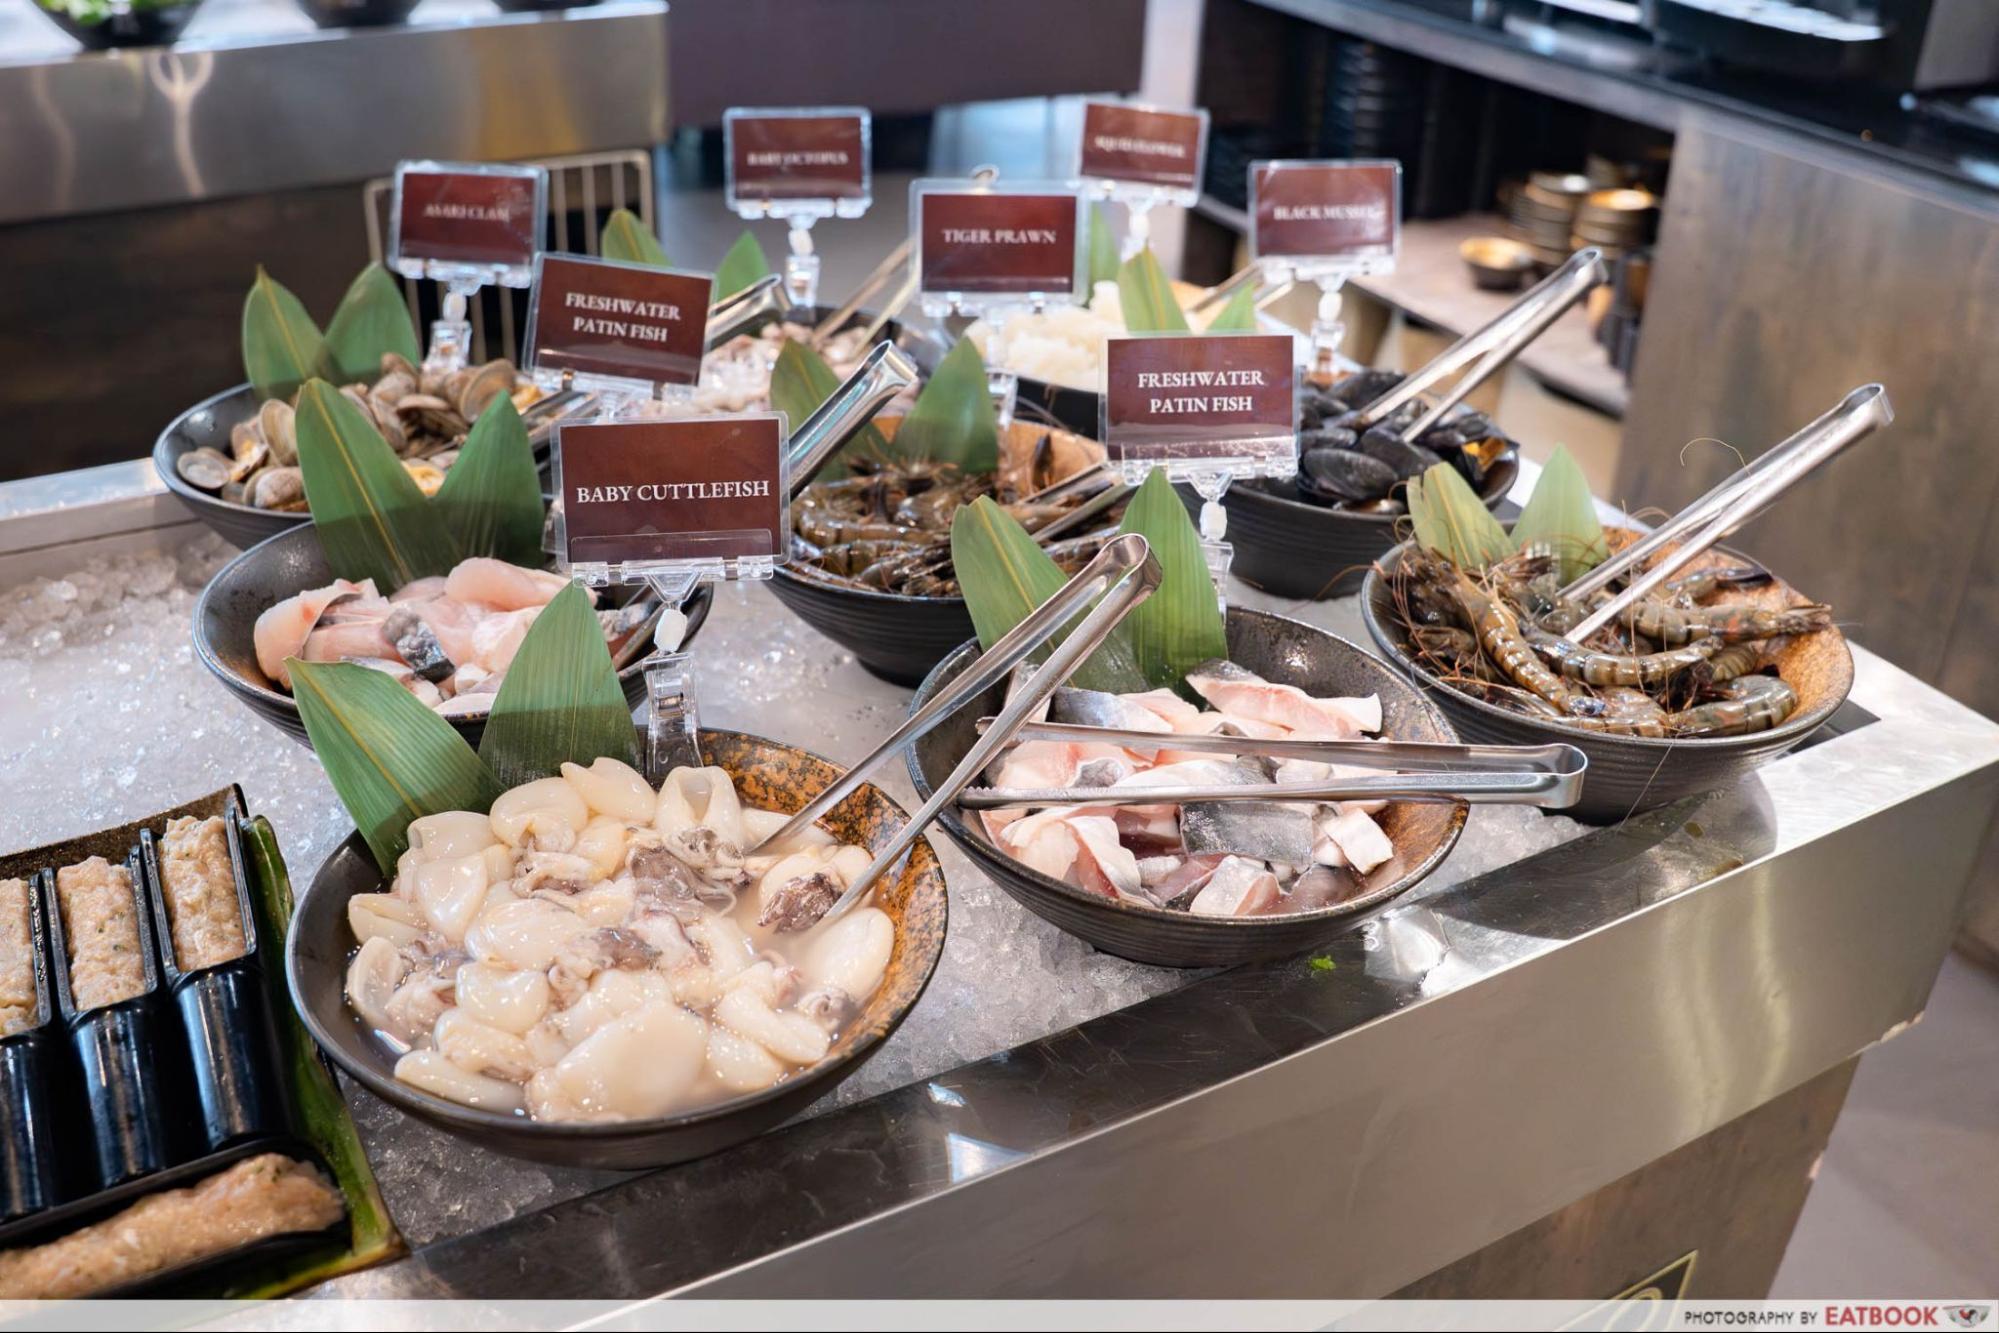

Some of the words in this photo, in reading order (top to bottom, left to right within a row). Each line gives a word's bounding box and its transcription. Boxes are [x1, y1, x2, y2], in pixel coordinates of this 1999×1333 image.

[1273, 205, 1321, 221] BLACK
[942, 228, 991, 244] TIGER
[994, 229, 1057, 245] PRAWN
[565, 292, 681, 321] FRESHWATER
[573, 317, 626, 337] PATIN
[629, 325, 668, 342] FISH
[1137, 370, 1265, 389] FRESHWATER
[1149, 397, 1209, 414] PATIN
[1212, 396, 1253, 412] FISH
[576, 484, 634, 504] BABY
[637, 479, 770, 501] CUTTLEFISH
